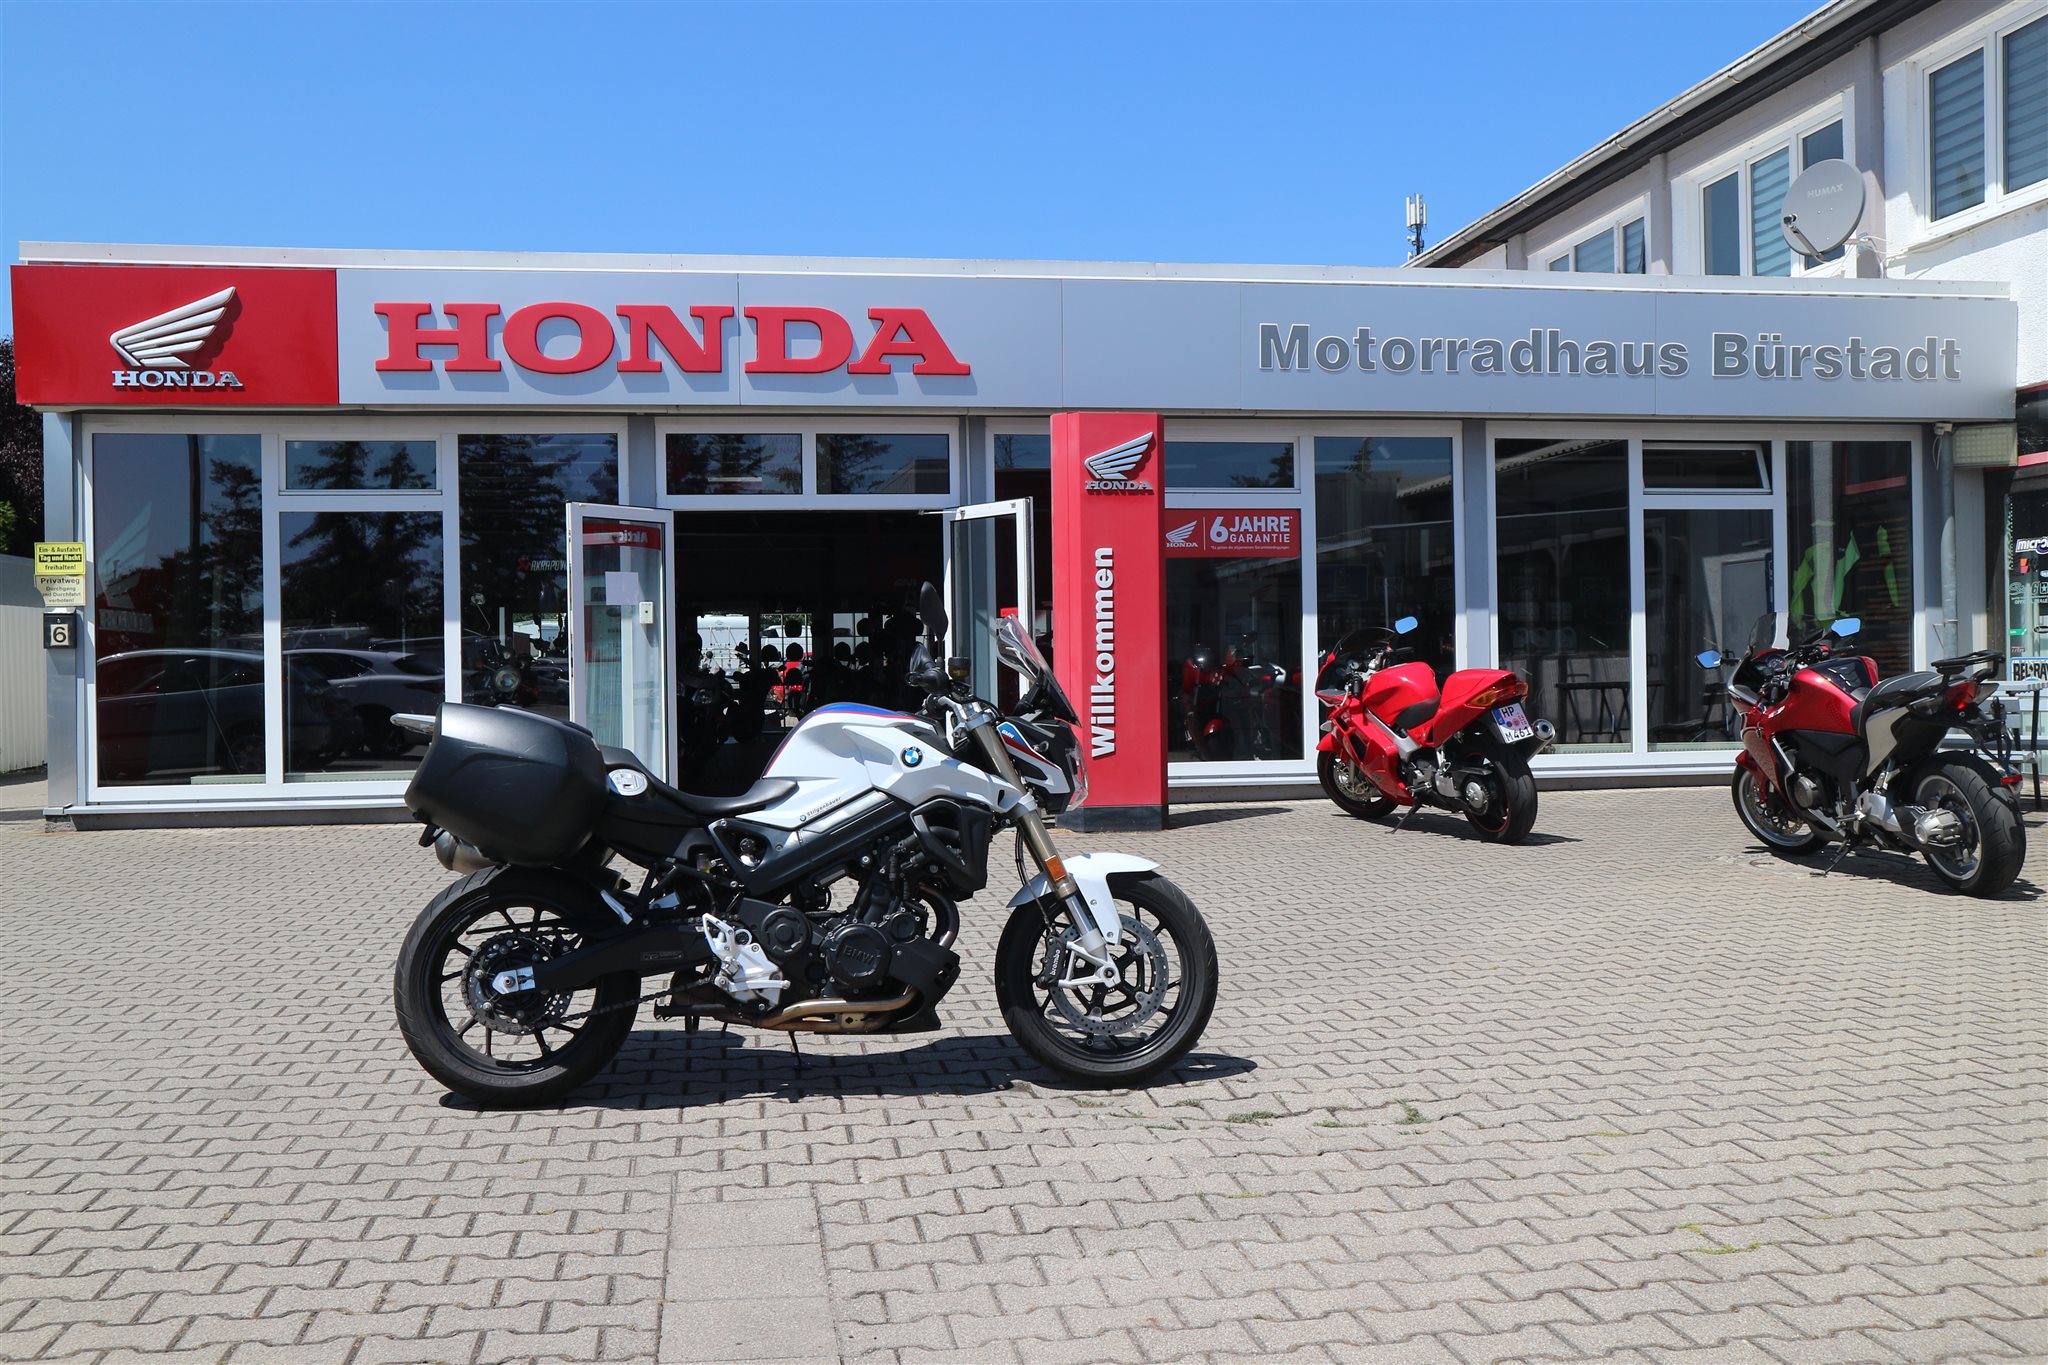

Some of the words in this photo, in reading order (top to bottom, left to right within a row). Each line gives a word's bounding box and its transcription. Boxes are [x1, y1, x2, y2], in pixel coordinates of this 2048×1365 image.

[1807, 184, 1843, 198] HUMAX
[374, 302, 971, 375] HONDA
[1258, 322, 1690, 376] Motorradhaus
[1711, 331, 1962, 381] Bürstadt
[112, 370, 243, 387] HONDA
[1085, 480, 1153, 491] HONDA
[1210, 516, 1229, 543] 6
[1229, 533, 1290, 543] GARANTIE
[53, 626, 67, 643] 6
[1091, 547, 1116, 758] Willkommen
[1501, 706, 1515, 718] HP
[1001, 729, 1015, 739] BMW
[1050, 949, 1061, 976] brembo
